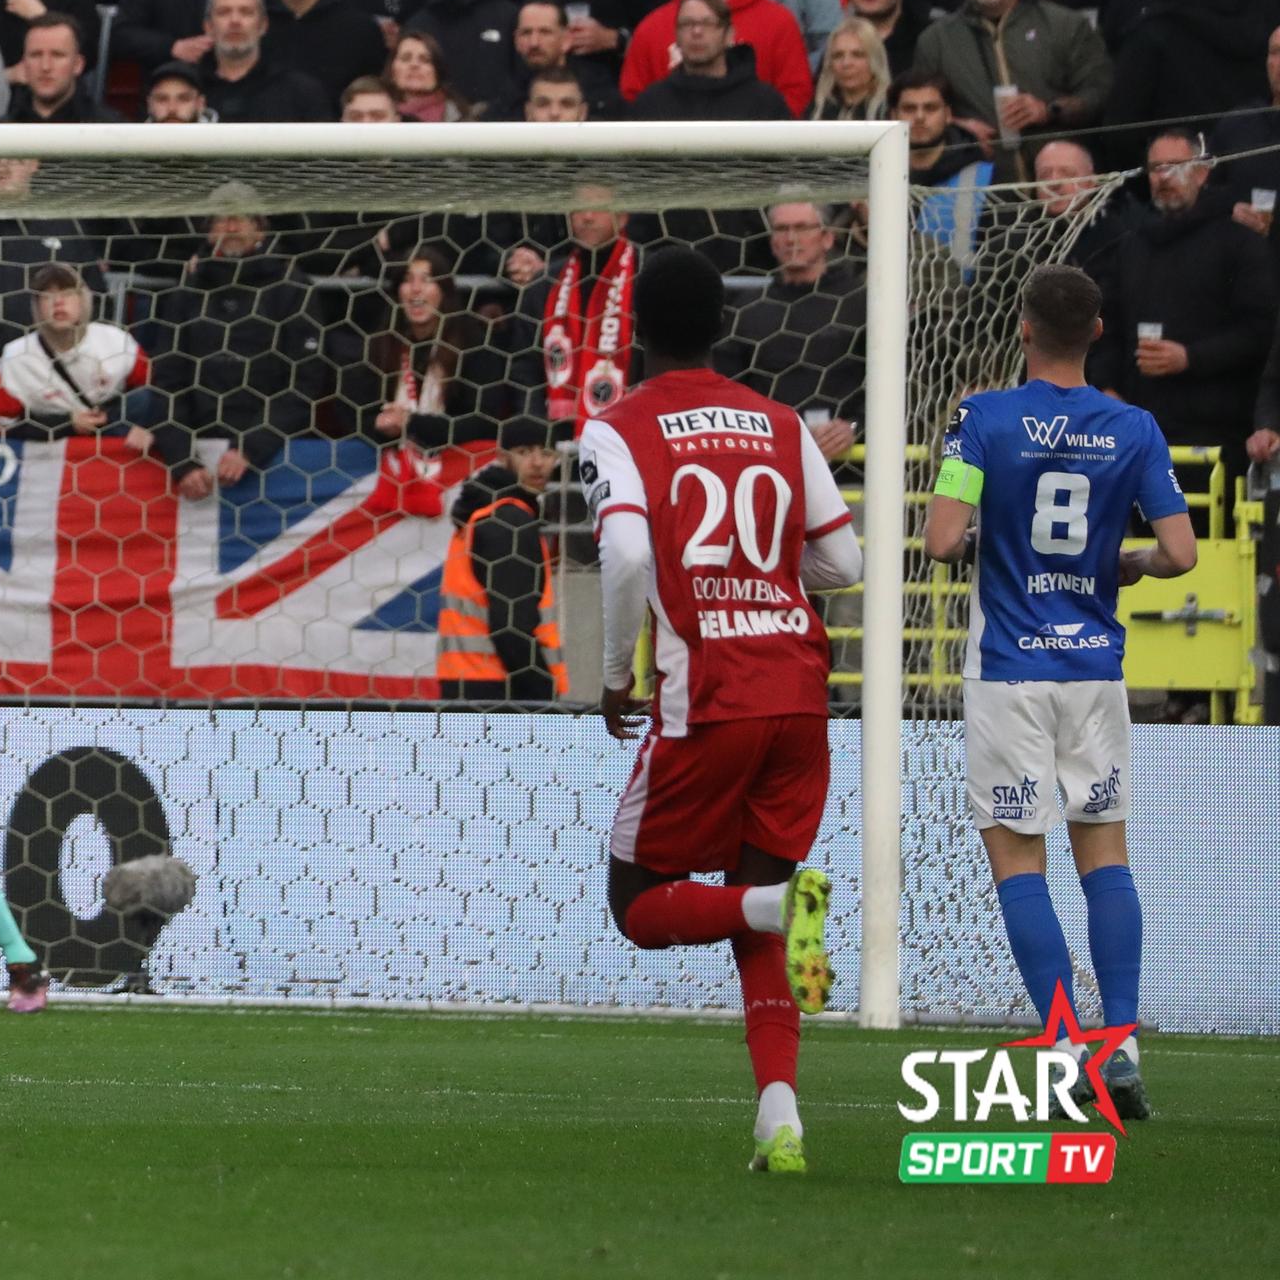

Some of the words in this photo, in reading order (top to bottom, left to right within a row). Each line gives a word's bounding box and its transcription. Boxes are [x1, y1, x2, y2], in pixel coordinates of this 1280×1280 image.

[663, 410, 769, 435] HEYLEN
[671, 438, 773, 453] VASTGOED
[1064, 433, 1116, 449] WILMS
[670, 463, 792, 573] 20
[1030, 471, 1091, 556] 8
[692, 576, 793, 602] DOUMBIA
[1027, 573, 1096, 596] HEYNEN
[697, 607, 810, 639] ELAMCO
[1017, 634, 1110, 650] CARGLASS
[992, 785, 1031, 806] STAR
[993, 807, 1021, 819] SPORT
[1023, 807, 1035, 818] TV
